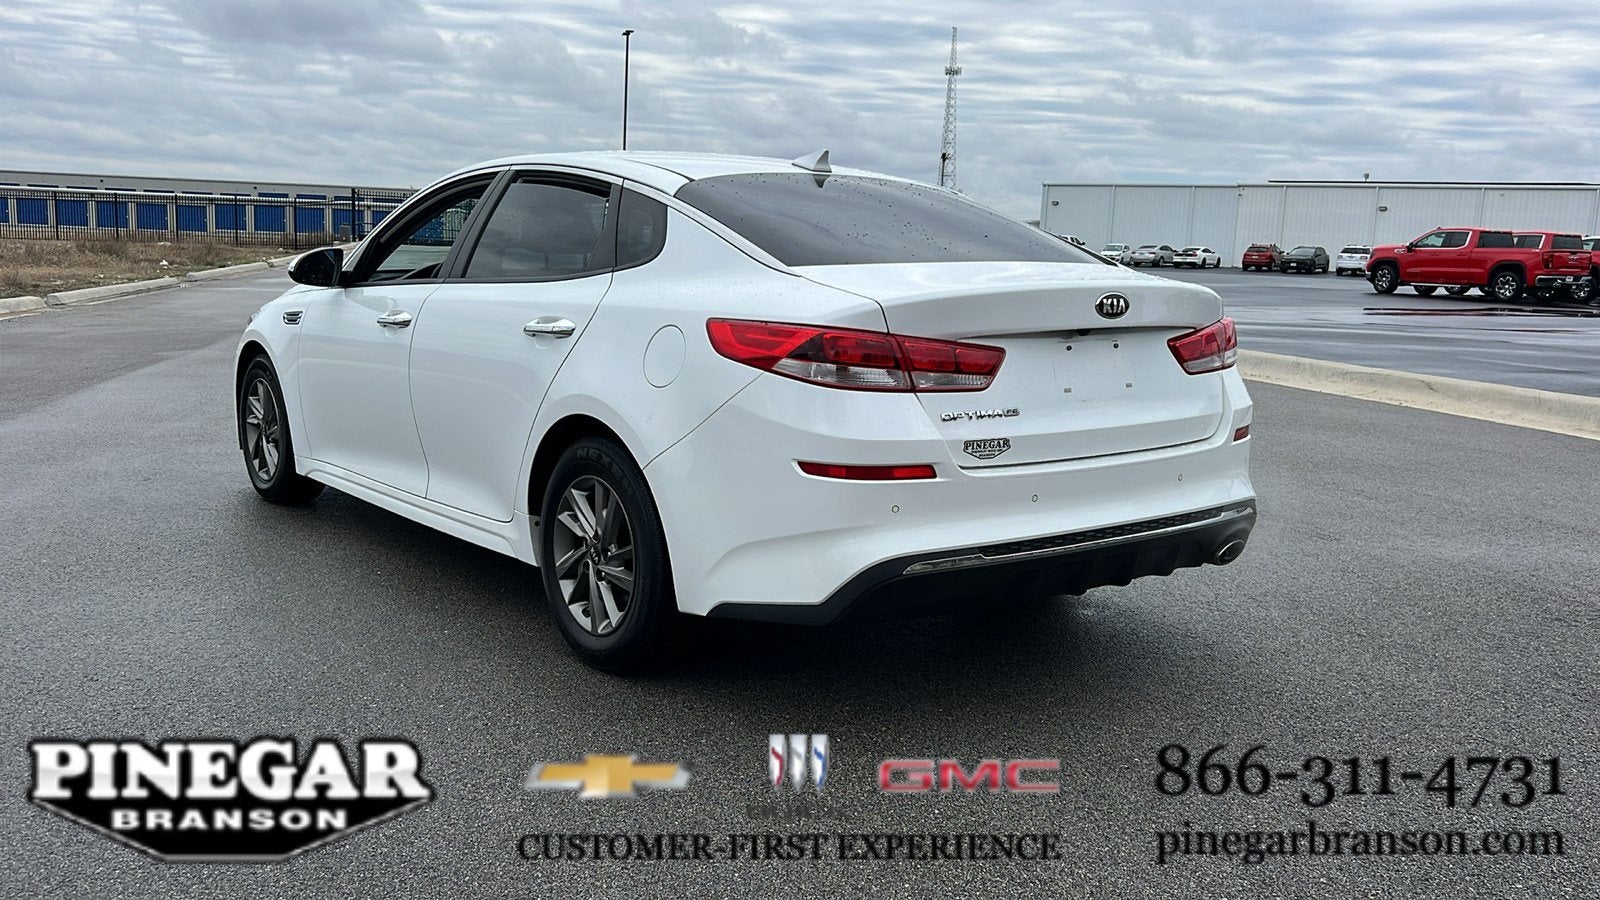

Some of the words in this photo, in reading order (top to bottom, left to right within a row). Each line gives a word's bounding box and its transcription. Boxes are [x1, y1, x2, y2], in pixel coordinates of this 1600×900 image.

[1102, 298, 1126, 314] KIA
[941, 409, 1003, 421] OPTIMA
[965, 439, 1010, 450] PINEGAR
